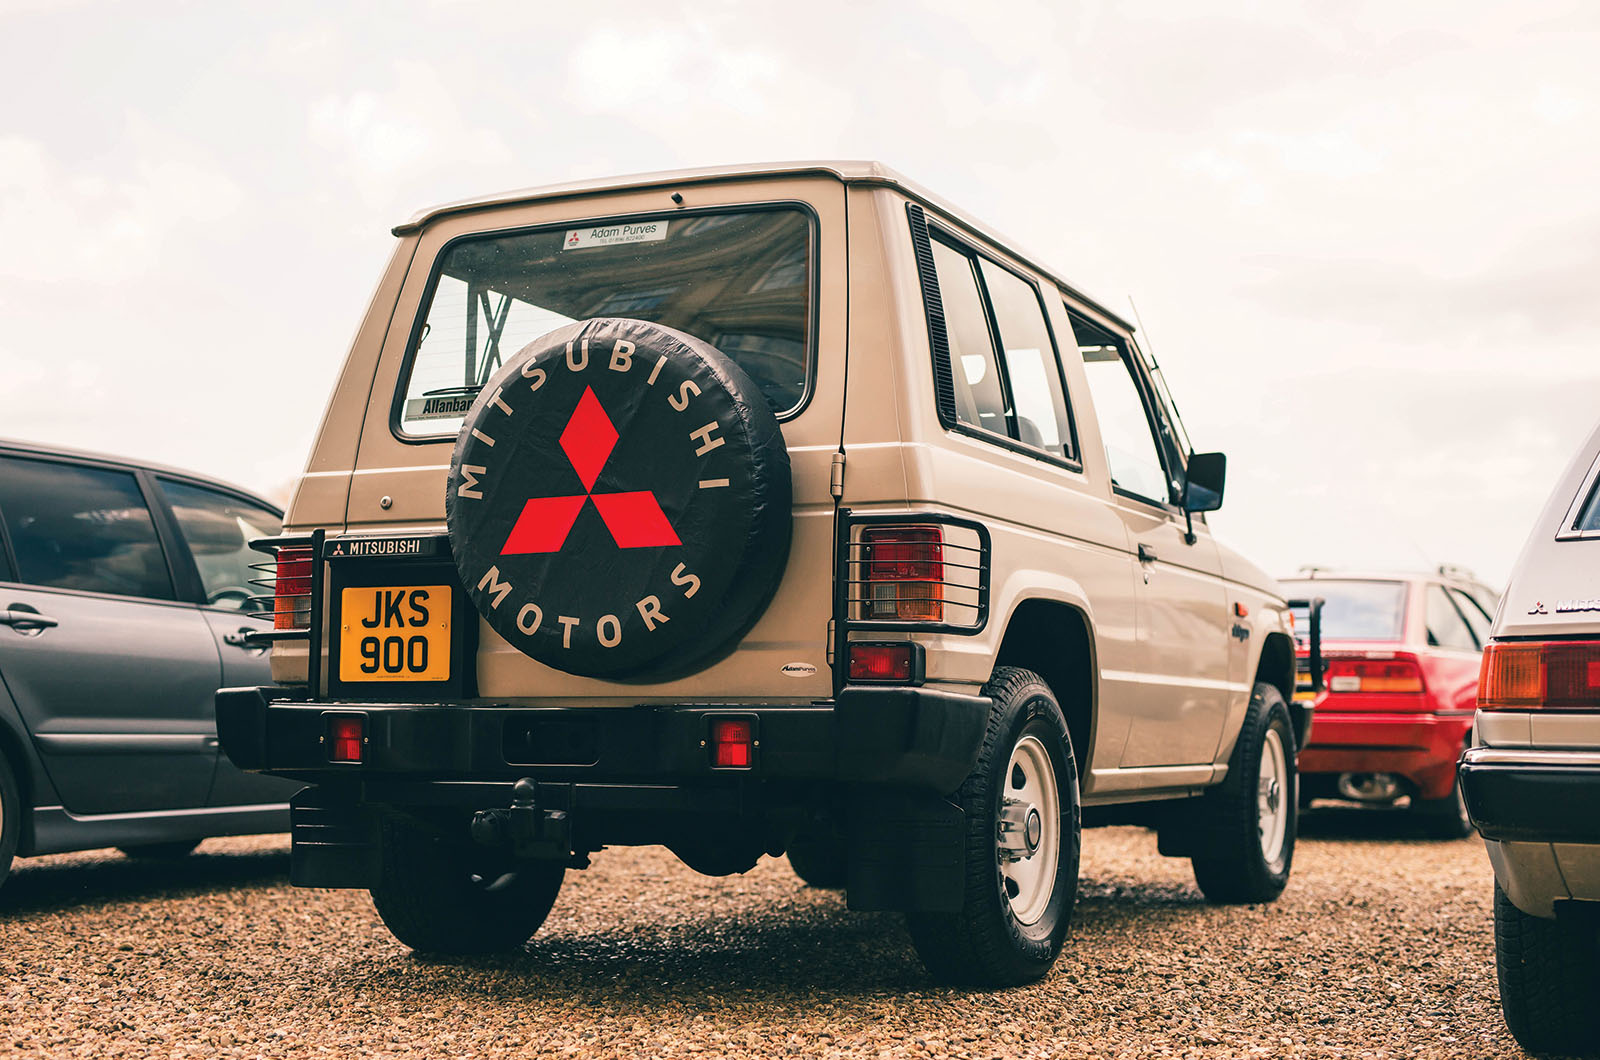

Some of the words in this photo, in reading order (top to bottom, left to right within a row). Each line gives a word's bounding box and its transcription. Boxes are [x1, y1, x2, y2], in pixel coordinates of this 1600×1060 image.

[591, 228, 620, 239] Adam
[623, 224, 657, 236] Purves
[457, 338, 730, 500] MITSUBISHI
[350, 539, 420, 555] MITSUBISHI
[361, 590, 430, 629] JKS
[477, 562, 701, 649] MOTORS
[360, 635, 429, 674] 900
